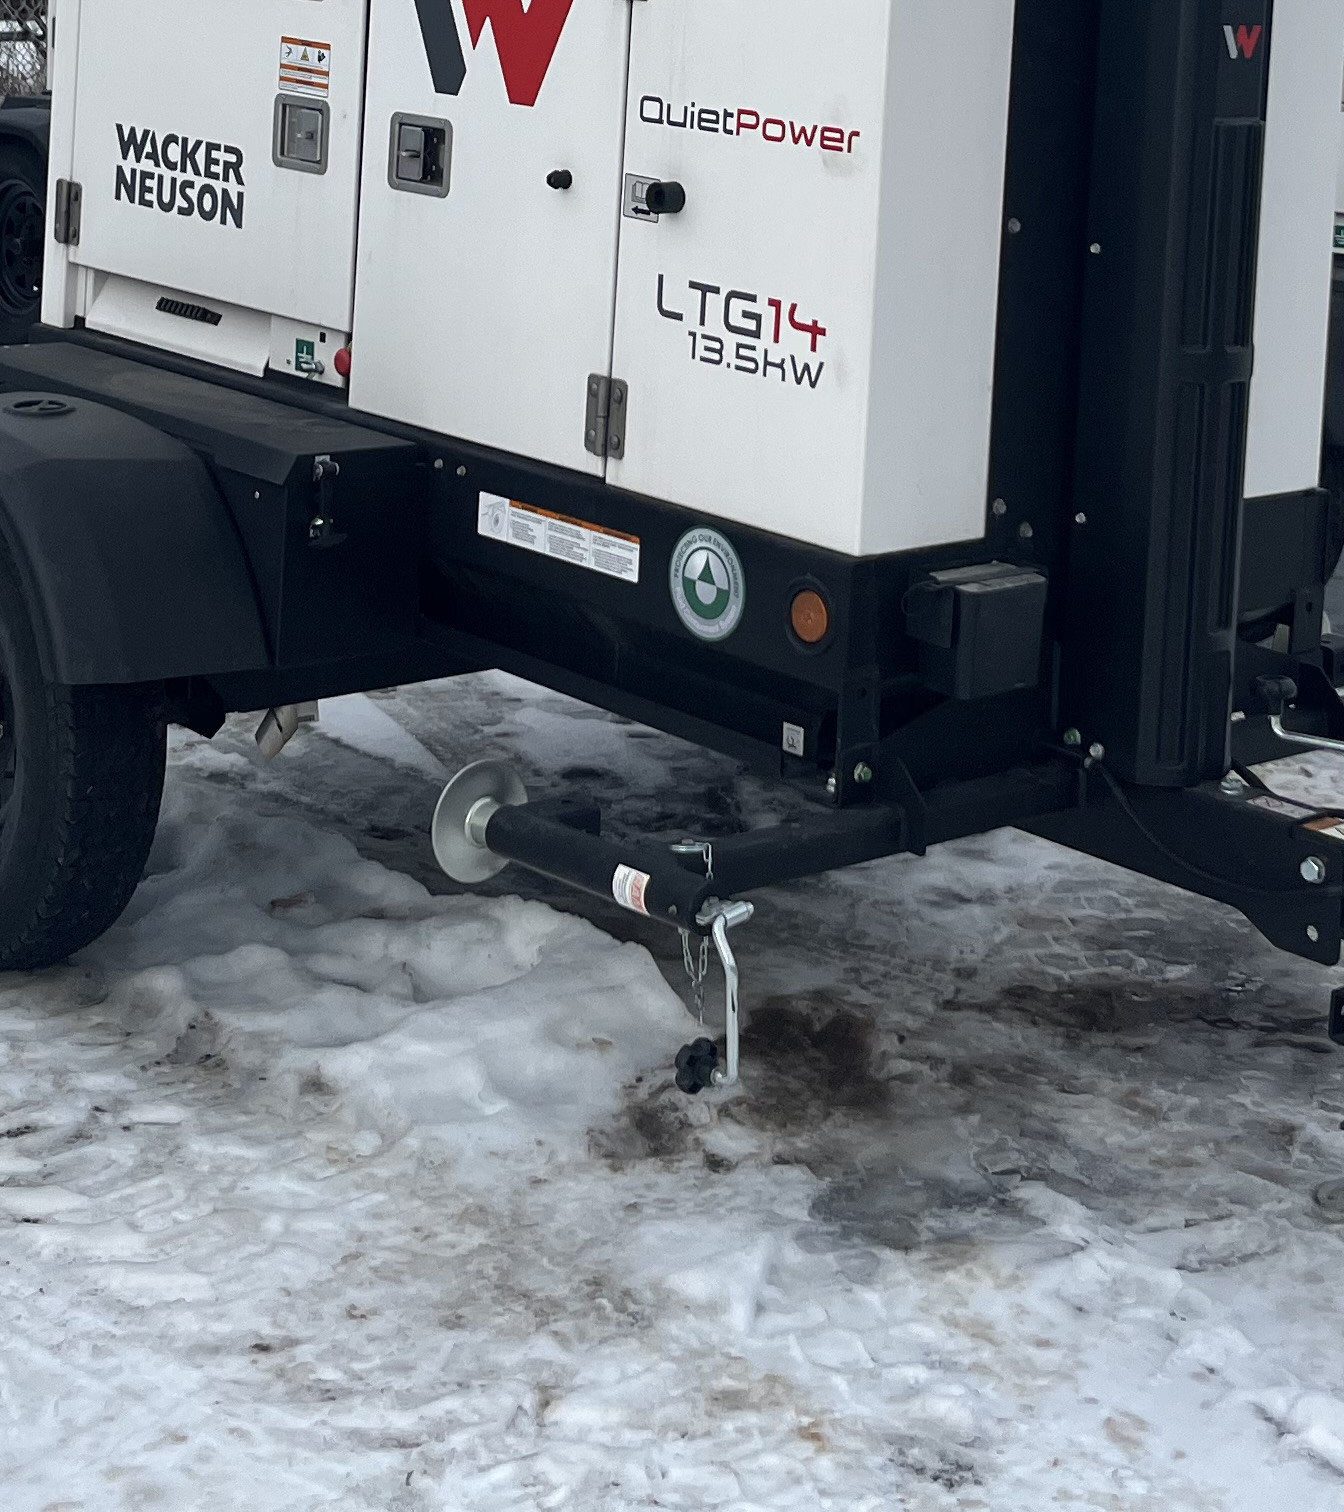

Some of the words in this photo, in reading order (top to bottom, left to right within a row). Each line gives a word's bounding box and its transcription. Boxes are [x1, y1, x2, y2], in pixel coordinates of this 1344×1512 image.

[115, 122, 245, 187] WACKER
[639, 94, 861, 154] QuietPower
[114, 164, 244, 229] NEUSON
[656, 273, 826, 353] LTG14
[688, 329, 824, 389] 13.5kW
